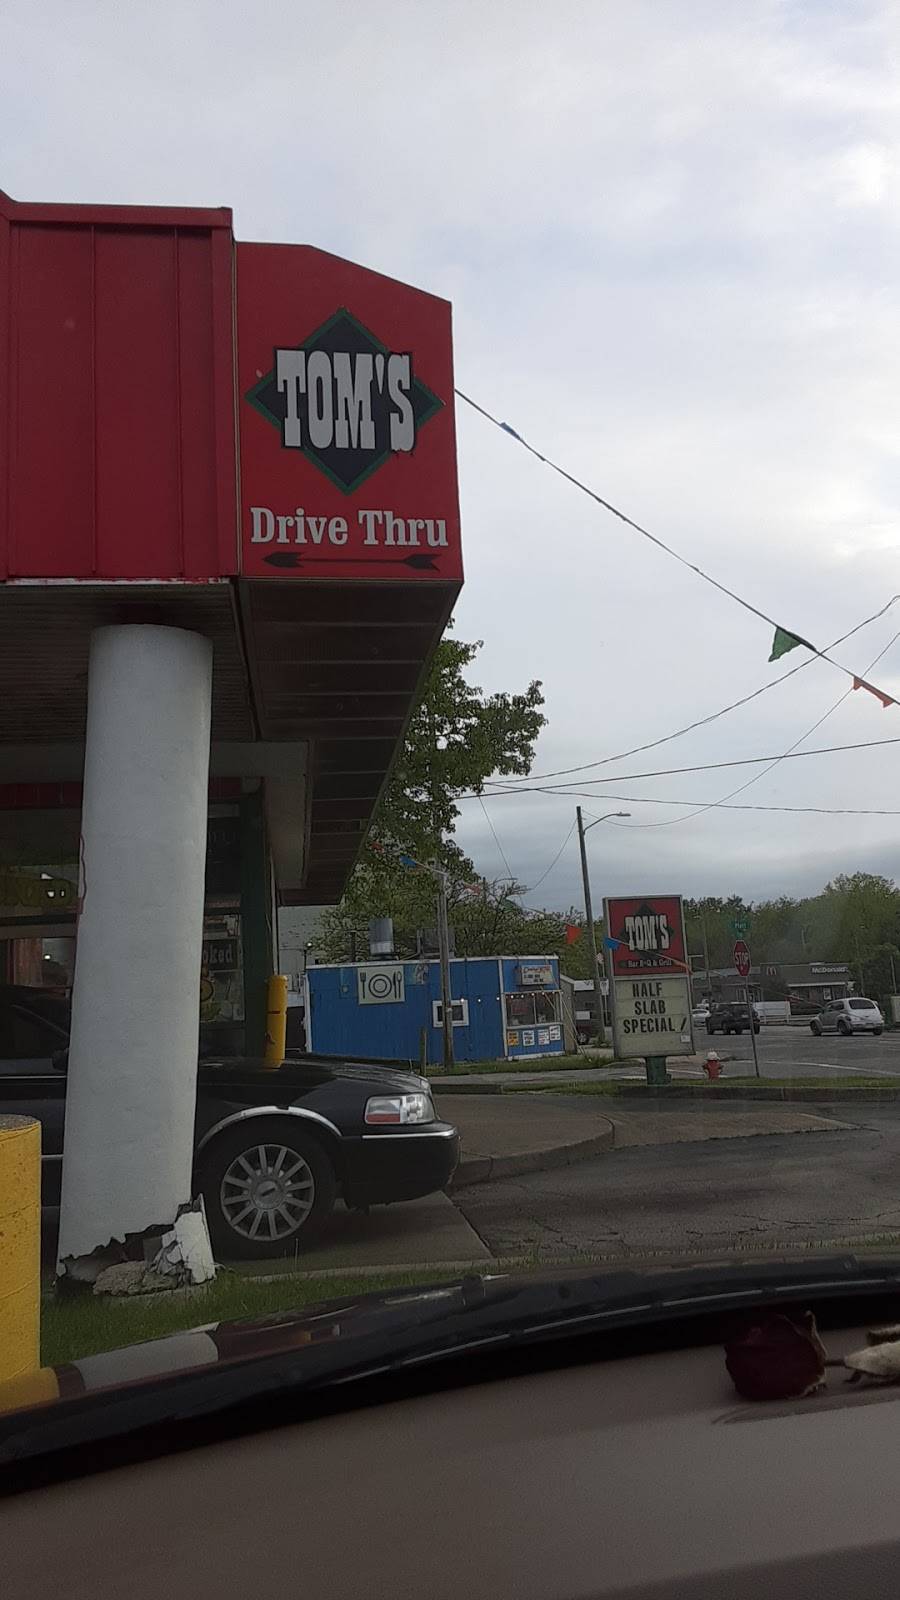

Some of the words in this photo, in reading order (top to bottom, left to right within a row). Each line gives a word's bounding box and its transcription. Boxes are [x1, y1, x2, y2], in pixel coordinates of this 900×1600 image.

[276, 349, 415, 452] TOM'S
[250, 507, 348, 545] Drive
[358, 509, 449, 546] Thru
[625, 916, 669, 950] TOM'S
[735, 952, 748, 964] STOP
[633, 983, 662, 997] HALF
[634, 999, 666, 1016] SLAB
